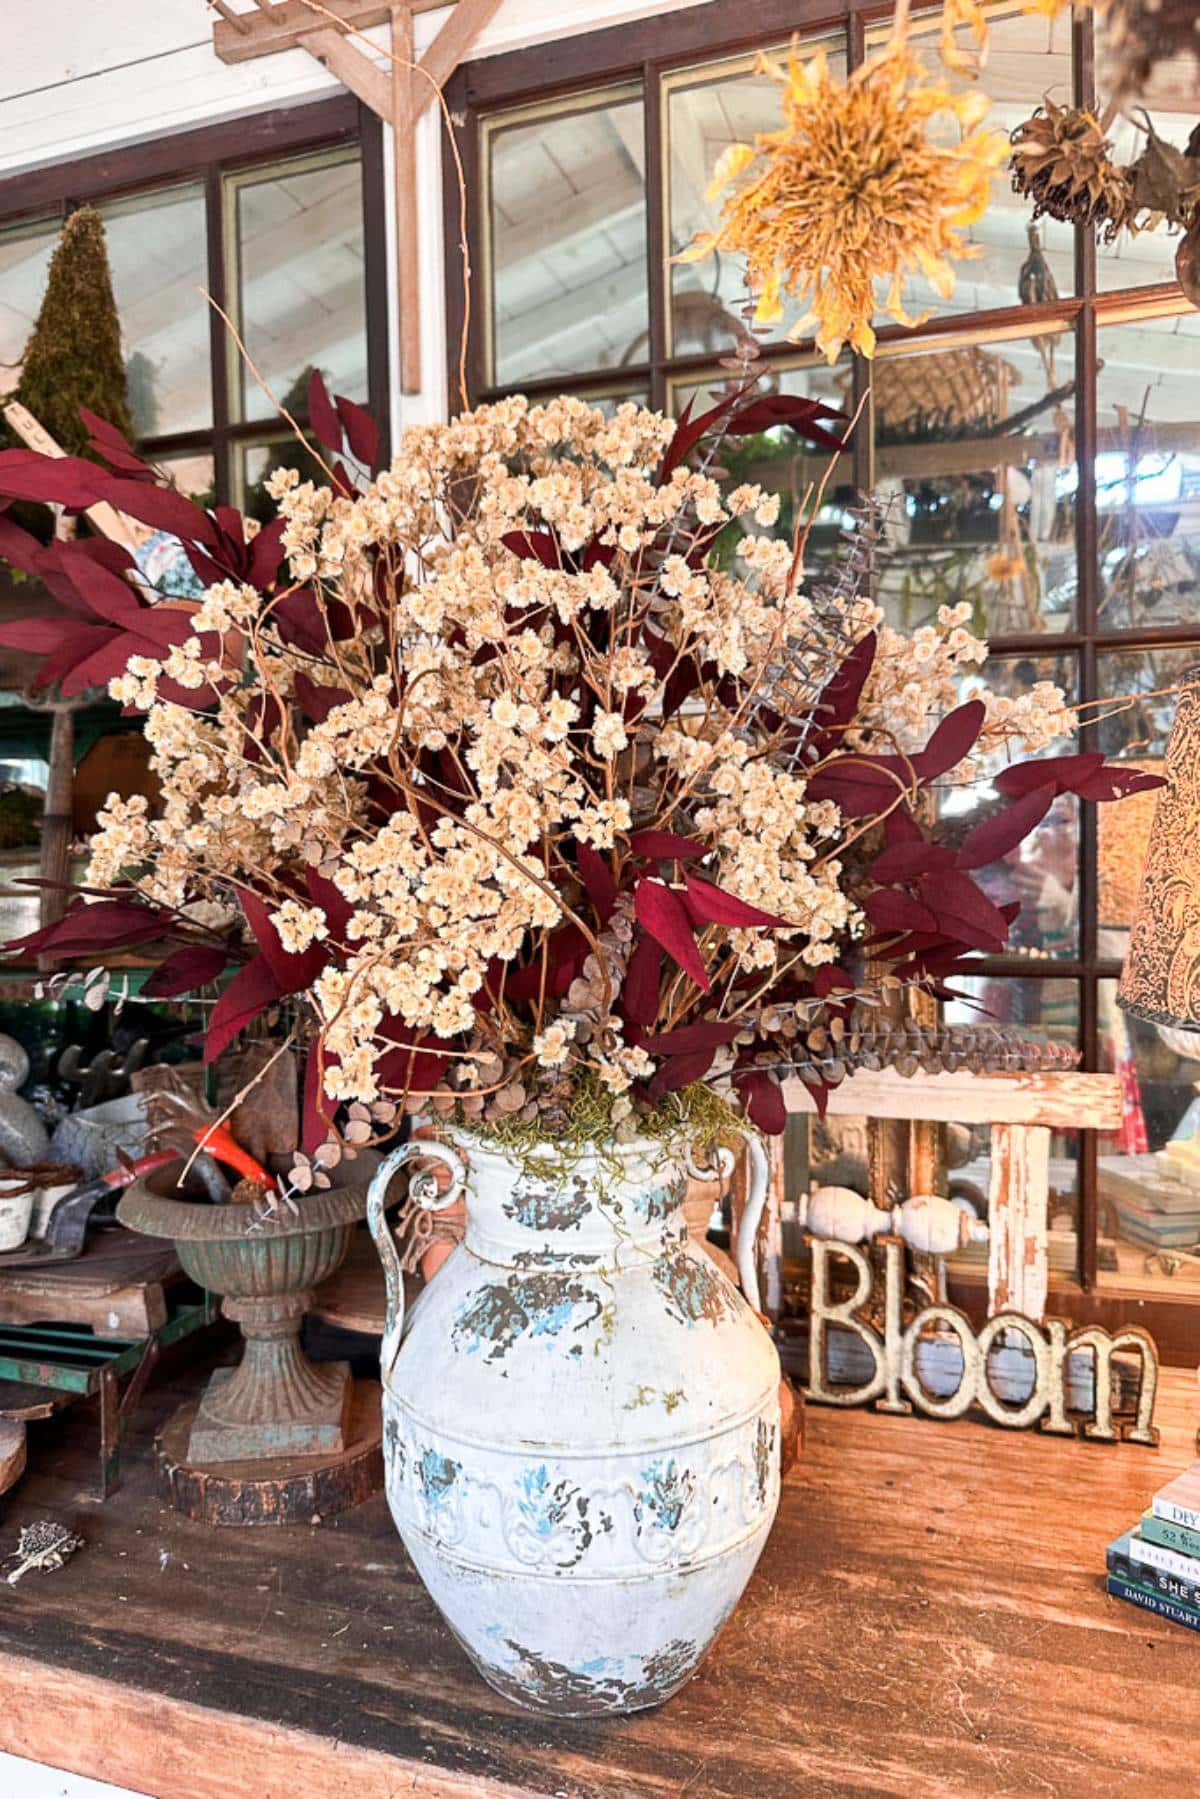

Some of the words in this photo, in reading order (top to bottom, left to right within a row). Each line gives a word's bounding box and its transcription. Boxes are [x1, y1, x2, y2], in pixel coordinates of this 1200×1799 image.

[803, 1236, 1160, 1446] Bloom
[1124, 1587, 1157, 1609] DAVID
[1159, 1602, 1199, 1626] STUART
[1158, 1576, 1189, 1599] SHE
